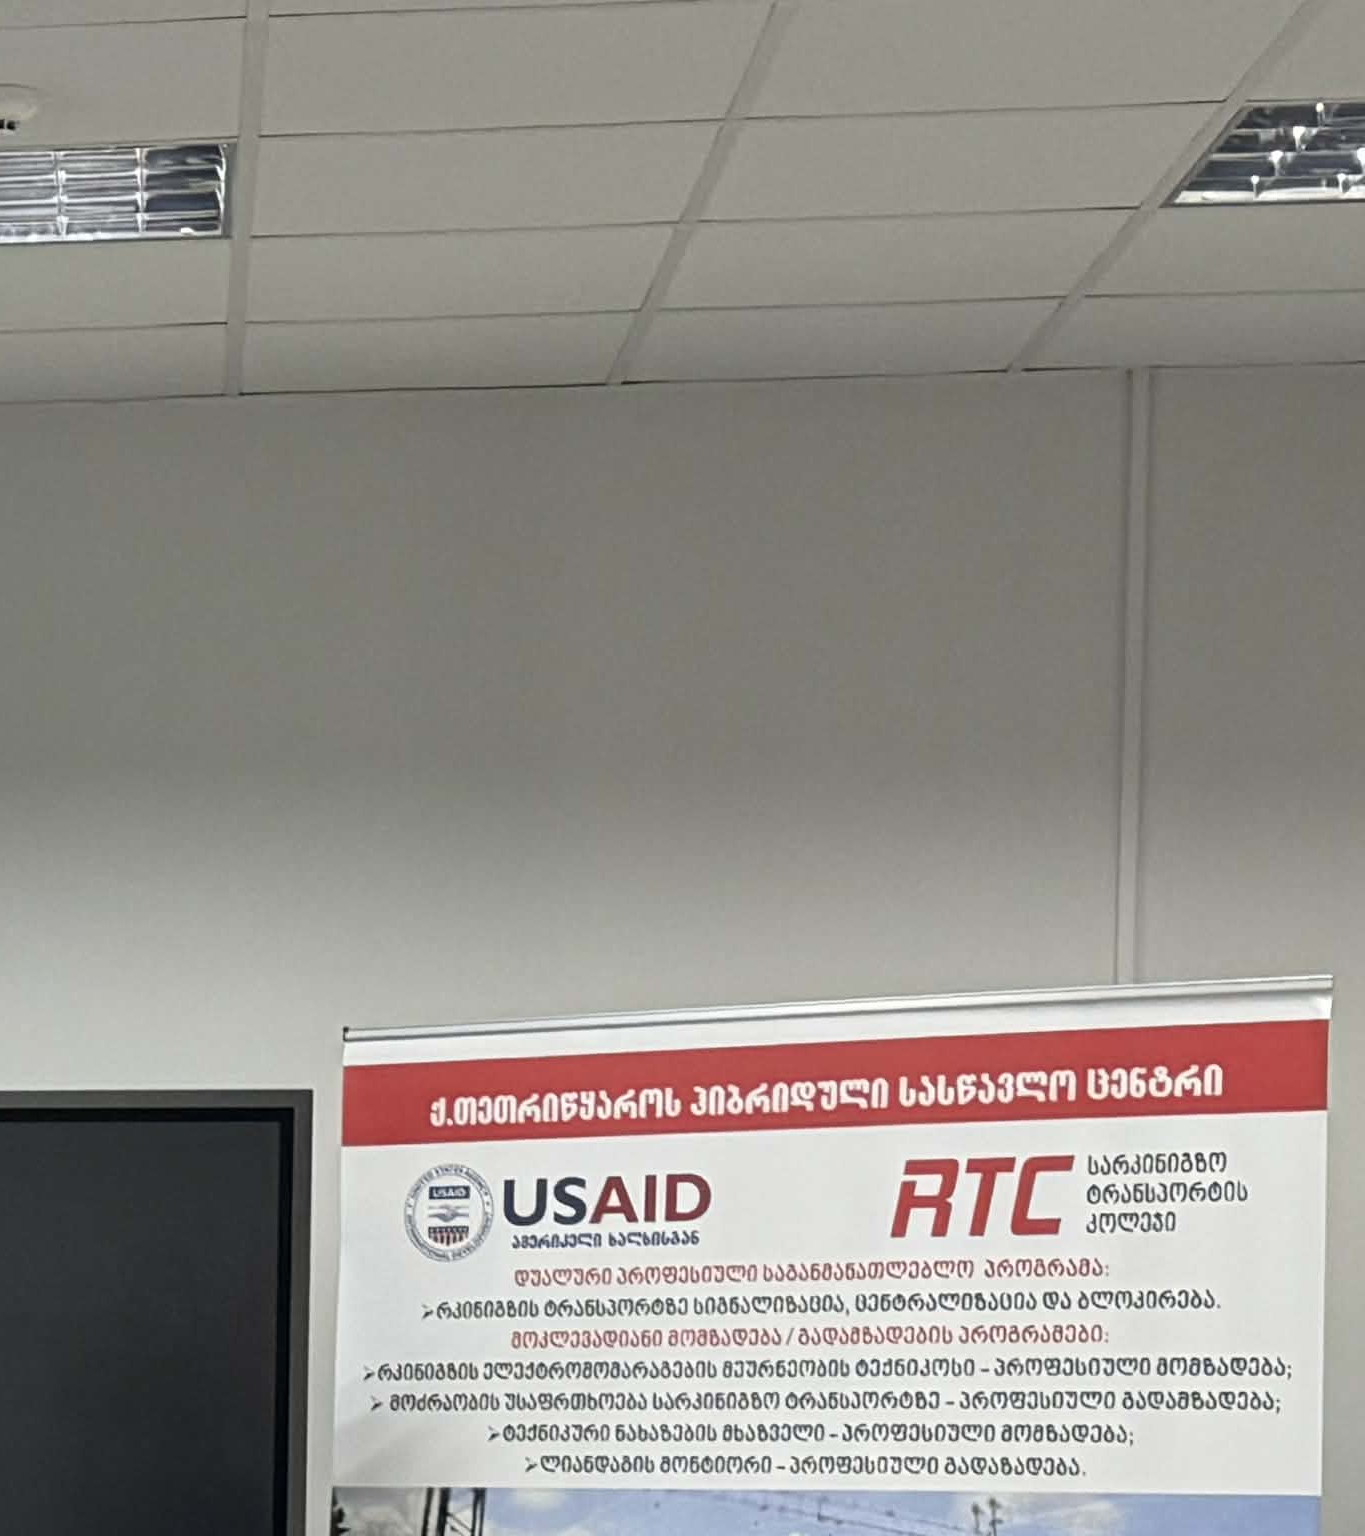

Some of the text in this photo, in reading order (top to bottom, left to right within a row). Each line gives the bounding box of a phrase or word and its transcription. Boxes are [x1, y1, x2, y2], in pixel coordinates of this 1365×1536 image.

[429, 1063, 1223, 1128] ქ.თეთრიწყაროს ჰიბრიდული სასწავლო ცენტრი
[1086, 1151, 1228, 1176] სარკინიგზო
[503, 1173, 712, 1227] USAID
[890, 1154, 1075, 1238] RTC
[1085, 1179, 1249, 1205] ტრანსპორტის
[1085, 1210, 1176, 1235] კოლეჯი
[511, 1230, 700, 1250] ამერიკელი ხალხისგან
[514, 1257, 1110, 1287] დუალური პროფესიული საგანმანათლებლო პროგრამა:
[436, 1288, 1221, 1320] რკინიგზის ტრანსპორტზე სიგნალიზაცია, ცენტრალიზაცია და ბლოკირება.
[511, 1323, 1110, 1349] მოკლევადიანი მომზადება / გადამზადების პროგრამები:
[377, 1362, 479, 1382] რკინიგზის
[483, 1360, 718, 1381] ელექტრომომარაგების
[722, 1359, 851, 1379] მეურნეობის
[855, 1358, 976, 1378] ტექნიკოსი
[994, 1357, 1150, 1377] პროფესიული
[1156, 1356, 1293, 1380] მომზადება;
[389, 1393, 500, 1412] მოძრაობის
[505, 1392, 647, 1412] უსაფრთხოება
[652, 1391, 781, 1411] სარკინიგზო
[785, 1390, 940, 1411] ტრანსპორტზე
[959, 1390, 1116, 1410] პროფესიული
[1122, 1390, 1282, 1415] გადამზადება;
[502, 1424, 611, 1442] ტექნიკური
[615, 1423, 717, 1442] ნახაზების
[722, 1423, 825, 1442] მხაზველი
[842, 1423, 996, 1442] პროფესიული
[1000, 1423, 1135, 1447] მომზადება;
[540, 1455, 655, 1474] ლიანდაგის
[660, 1456, 772, 1474] მონტიორი
[789, 1456, 939, 1475] პროფესიული
